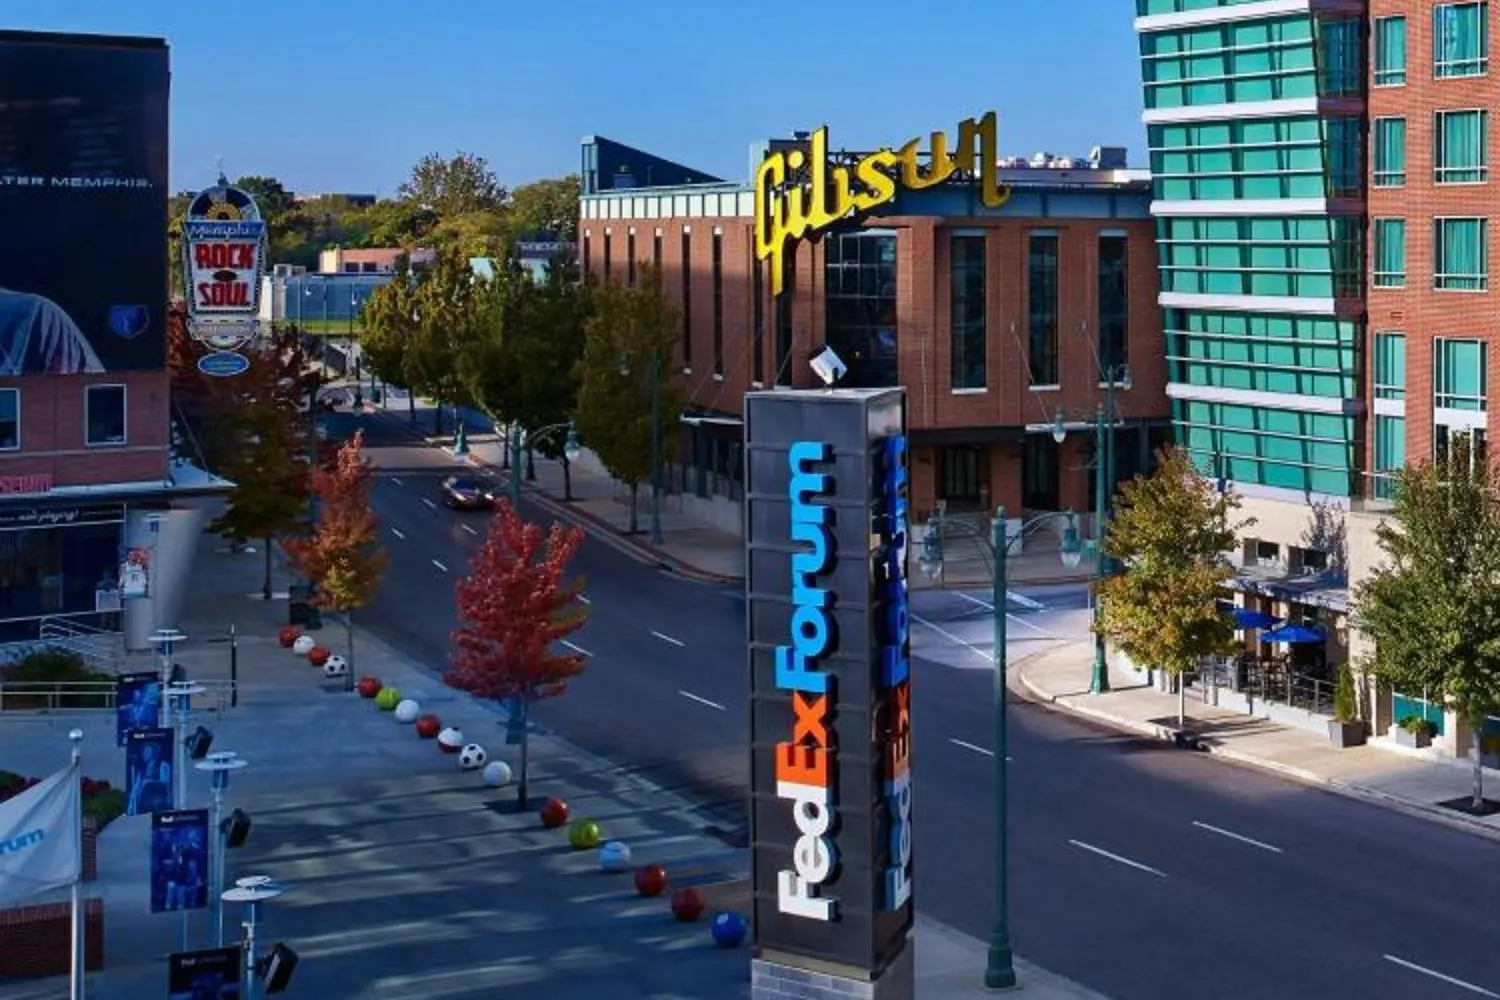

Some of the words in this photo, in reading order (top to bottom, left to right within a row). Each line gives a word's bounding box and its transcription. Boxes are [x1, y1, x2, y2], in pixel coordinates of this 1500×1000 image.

[51, 176, 153, 188] MEMPHIS.
[754, 111, 1010, 297] Gibson
[195, 243, 258, 269] ROCK
[197, 281, 251, 306] SOUL
[775, 440, 835, 921] FedExForum
